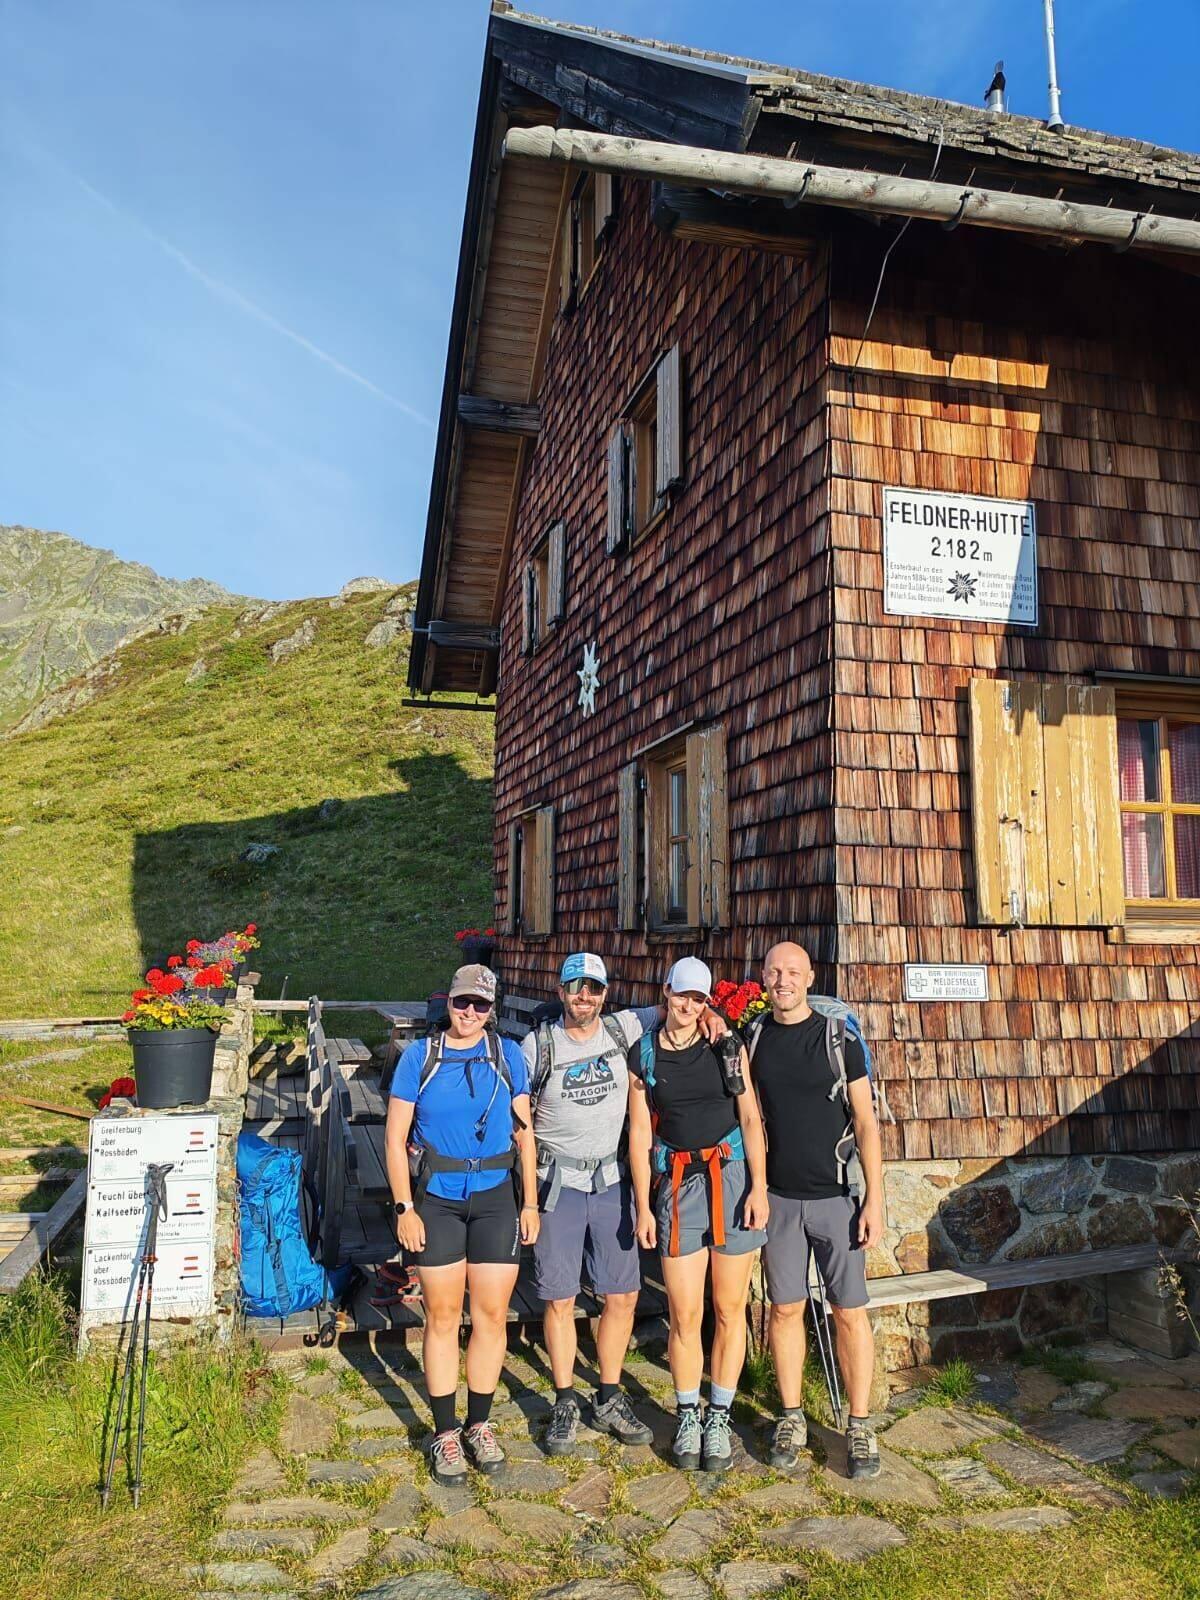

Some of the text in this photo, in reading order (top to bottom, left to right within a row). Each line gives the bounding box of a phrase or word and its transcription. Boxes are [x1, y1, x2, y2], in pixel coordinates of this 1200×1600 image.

[890, 501, 1030, 537] FELDNER-HÜTTE
[931, 536, 993, 562] 2.182 m
[890, 571, 911, 581] Jahren
[933, 978, 977, 986] MELDESTELLE
[560, 1083, 618, 1099] PATAGONIA
[101, 1125, 142, 1135] Greifenburg
[97, 1190, 147, 1201] Teuchl über
[96, 1205, 145, 1217] Kaltseetörl
